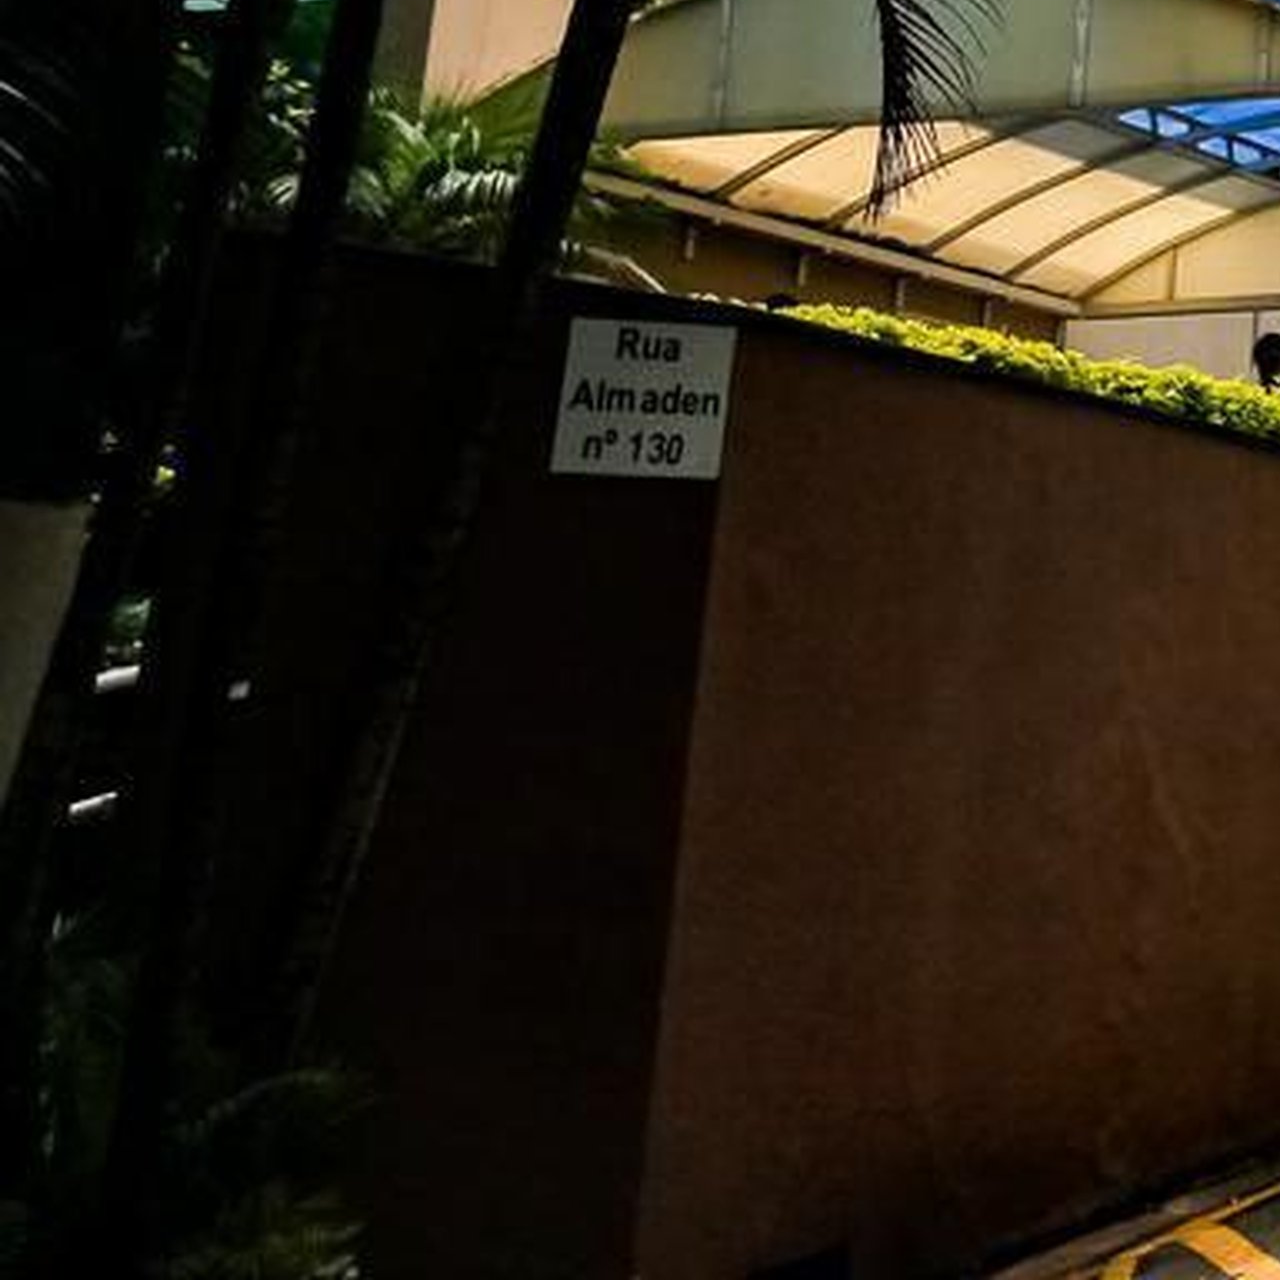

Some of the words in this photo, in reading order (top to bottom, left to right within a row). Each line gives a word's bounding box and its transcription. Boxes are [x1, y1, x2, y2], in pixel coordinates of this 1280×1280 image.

[615, 327, 682, 362] Rua
[566, 377, 720, 417] Almaden
[628, 431, 685, 465] 130
